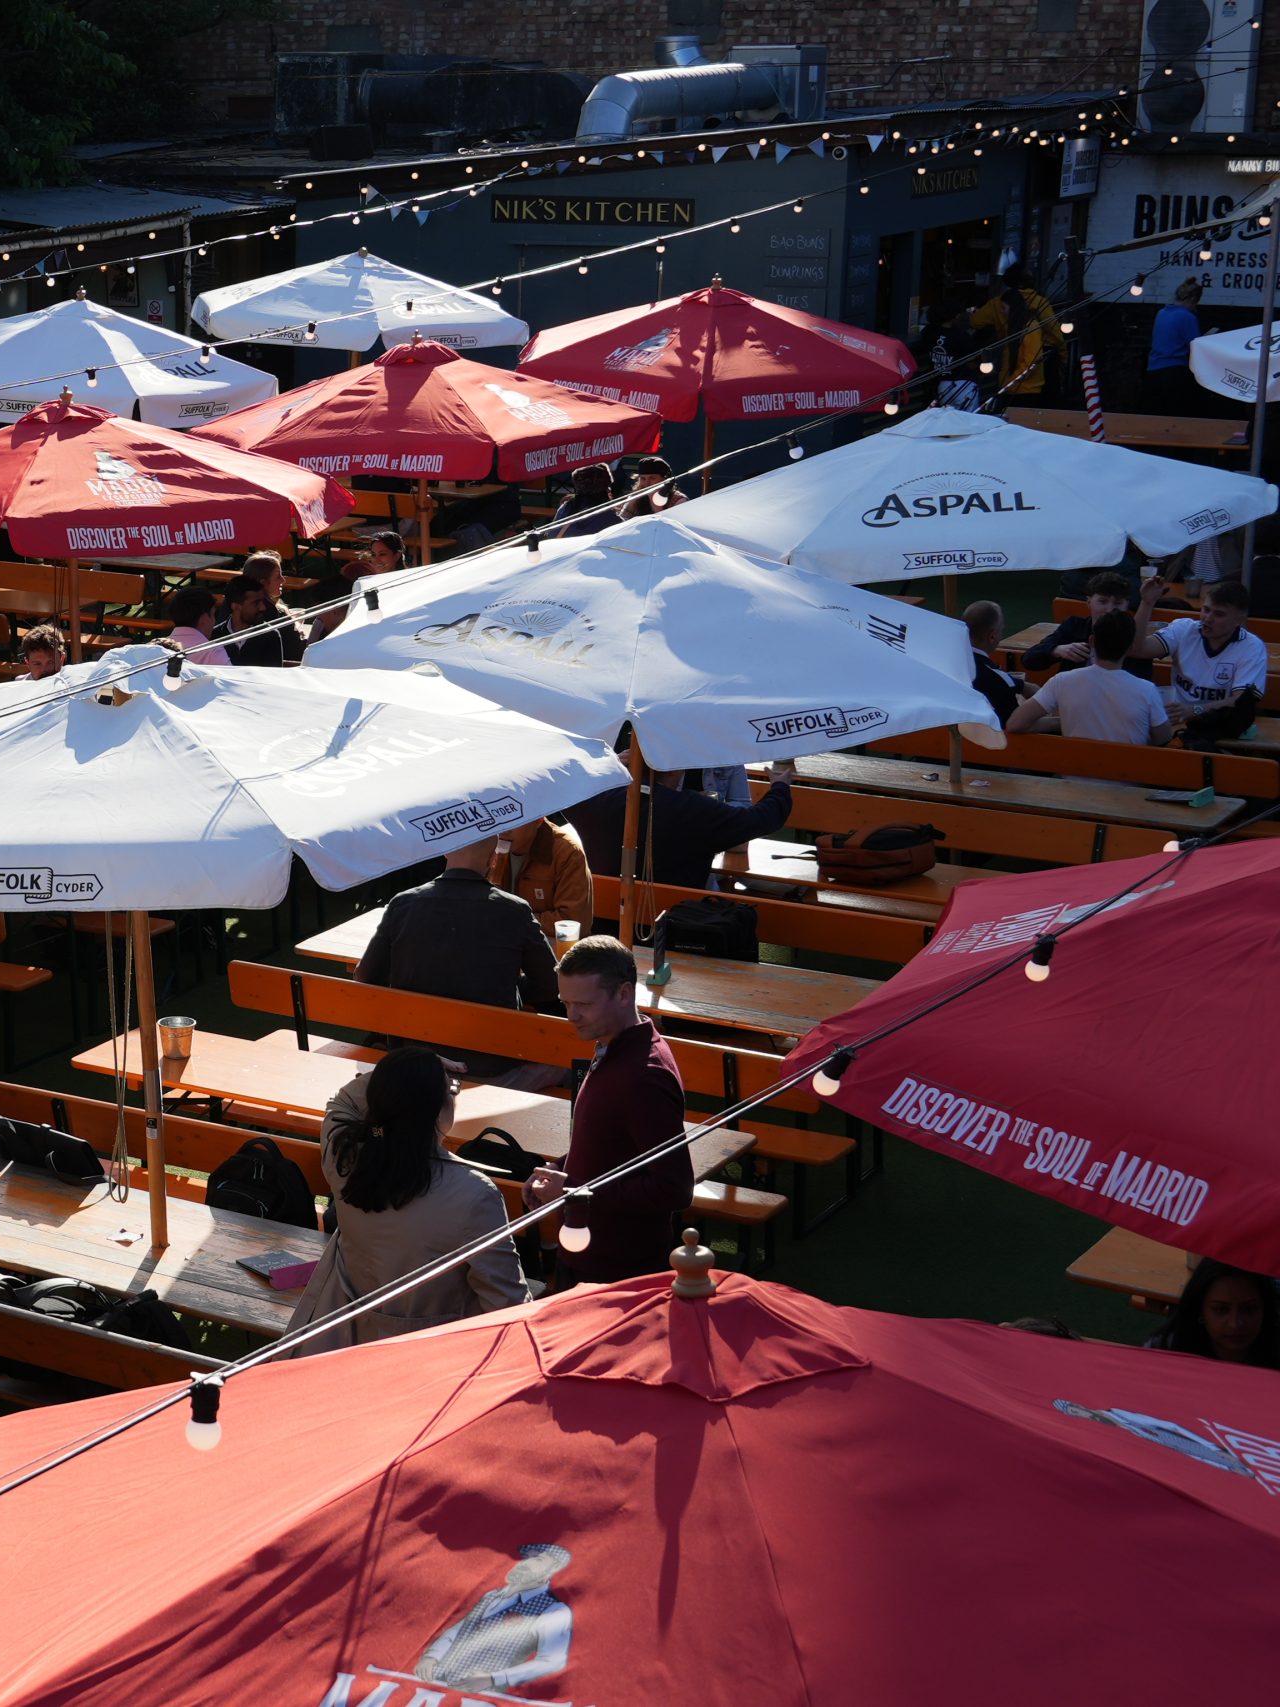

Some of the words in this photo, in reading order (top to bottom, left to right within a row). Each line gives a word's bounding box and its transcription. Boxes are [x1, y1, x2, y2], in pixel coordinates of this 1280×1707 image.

[1227, 160, 1262, 172] NANNY
[493, 198, 557, 221] NIK'S
[565, 201, 691, 223] KITCHEN
[1201, 273, 1212, 289] &
[6, 401, 36, 411] SUFFO
[628, 391, 661, 412] MADRID
[742, 393, 785, 413] DISCOVER
[794, 391, 817, 410] SOUL
[825, 390, 860, 409] MADRID
[299, 455, 351, 474] DISCOVER
[362, 453, 390, 470] SOUL
[399, 453, 444, 474] MADRID
[524, 446, 559, 473] DISCOVER
[565, 441, 586, 463] SOUL
[591, 433, 624, 457] MADRID
[862, 491, 1037, 528] ASPALL
[65, 527, 128, 550] DISCOVER
[126, 526, 141, 538] THE
[141, 524, 175, 548] SOUL
[175, 530, 185, 545] OF
[184, 518, 235, 545] MADRID
[914, 553, 968, 567] SUFFOLK
[976, 556, 1003, 564] CYDER
[765, 712, 837, 738] SUFFOLK
[848, 710, 884, 727] CYDER
[424, 805, 484, 836] SUFFOLK
[489, 802, 519, 818] CYDER
[55, 882, 94, 893] CYDER
[880, 1077, 1012, 1156] DISCOVER
[1007, 1117, 1040, 1154] THE
[1023, 1127, 1094, 1187] SOUL
[1080, 1160, 1110, 1191] OF
[1100, 1151, 1210, 1227] MADRID
